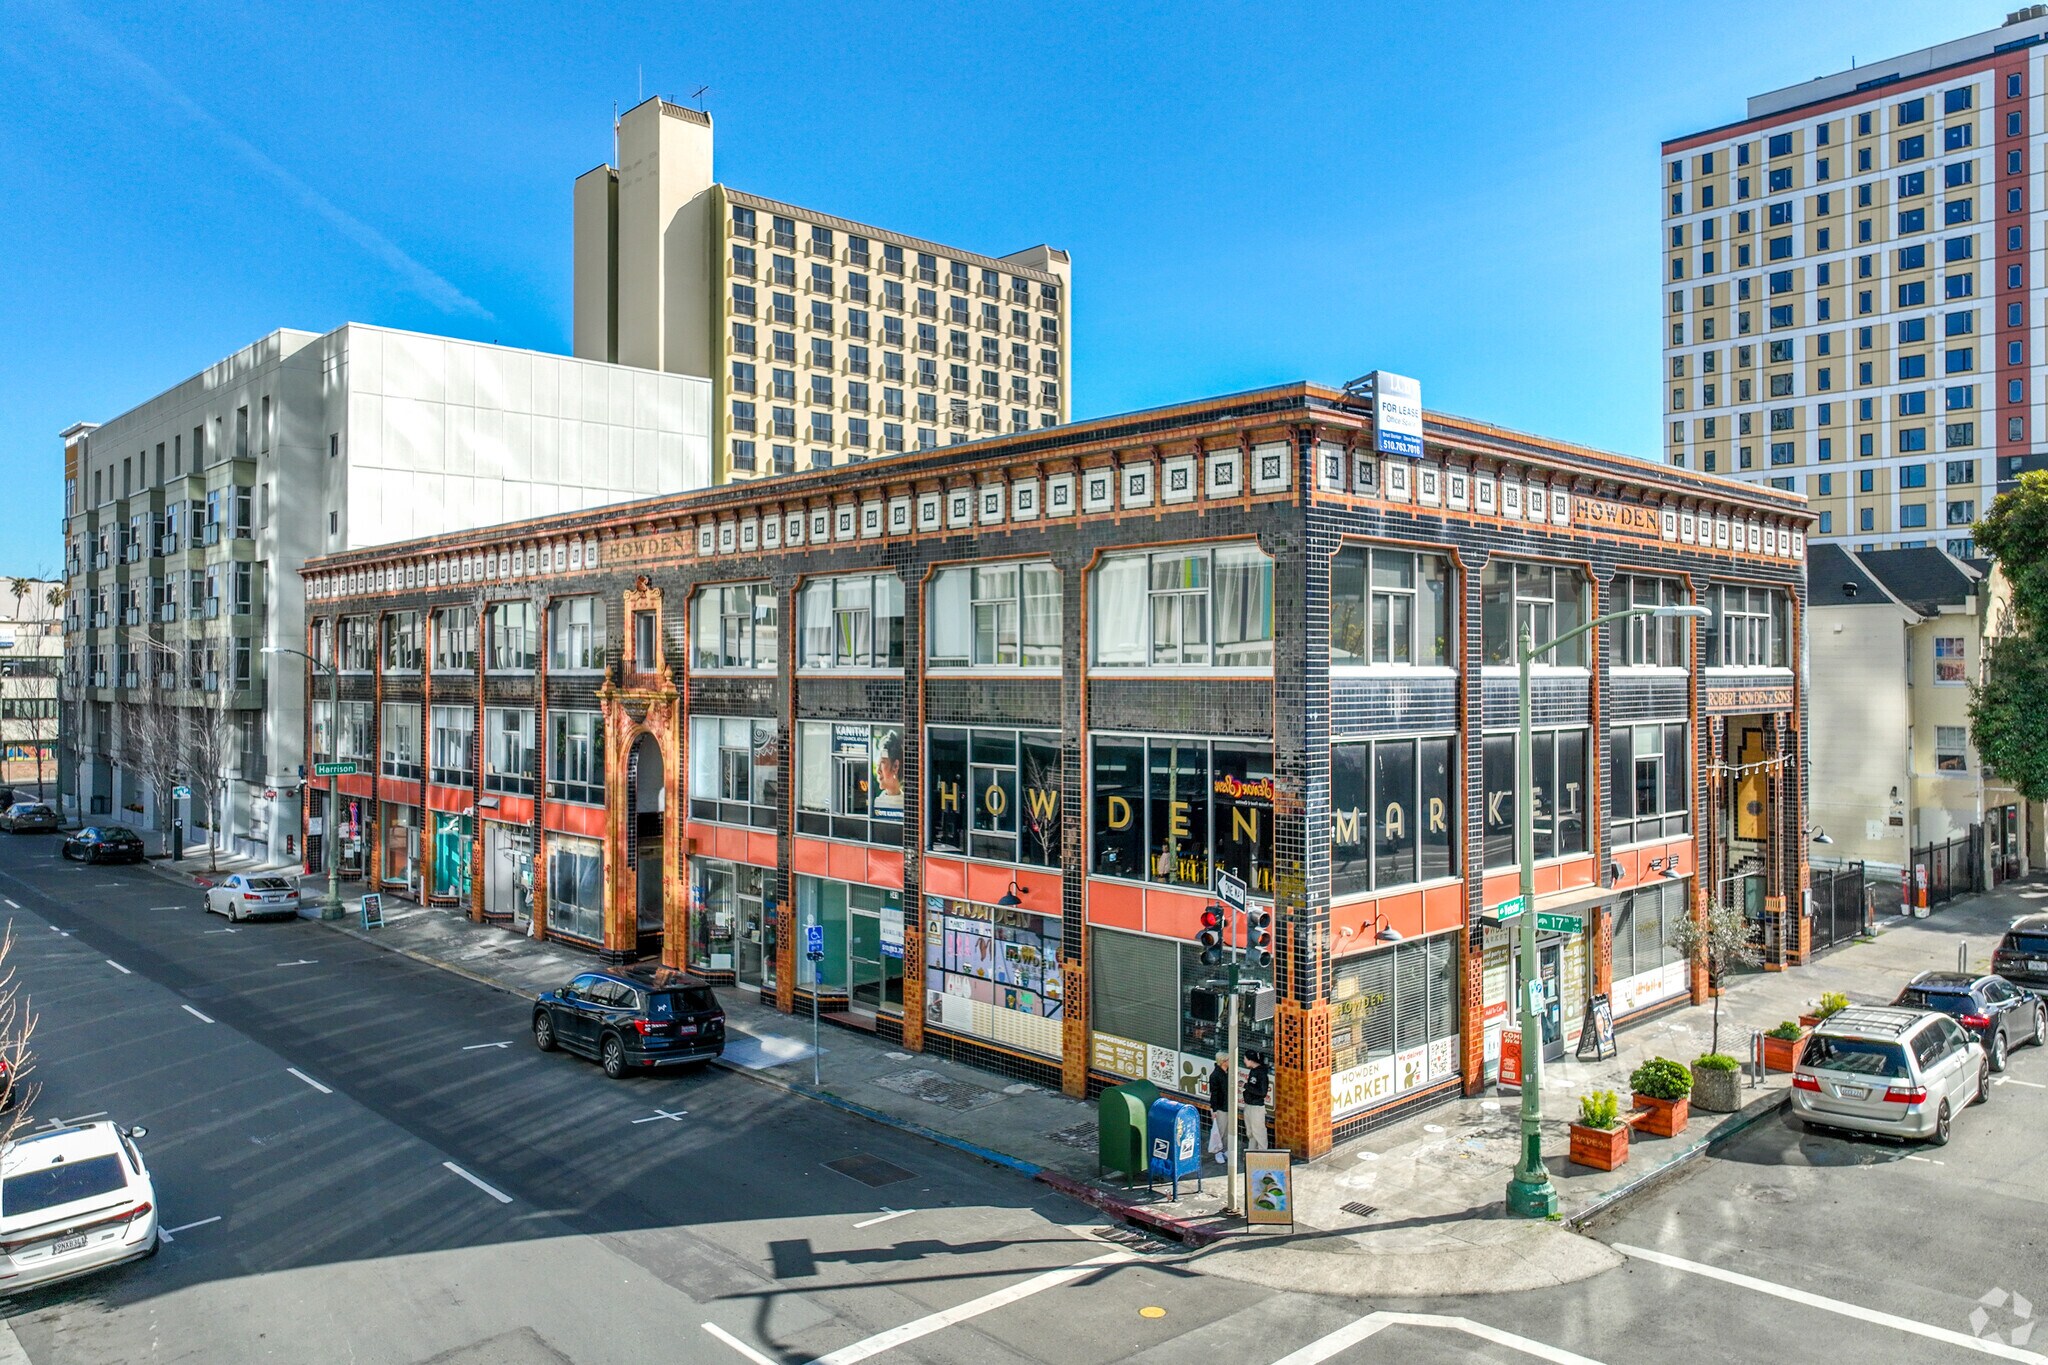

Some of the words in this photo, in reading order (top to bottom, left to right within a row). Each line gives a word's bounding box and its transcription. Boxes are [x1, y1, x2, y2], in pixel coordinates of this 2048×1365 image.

[1382, 401, 1397, 413] FOR
[1398, 405, 1419, 419] LEASE
[1386, 415, 1401, 425] Office
[1576, 498, 1657, 529] HOWDEN
[609, 535, 685, 559] HOWDEN
[1708, 692, 1736, 706] ROBERT
[1738, 691, 1768, 705] HOWDEN
[1774, 690, 1791, 703] SONS
[835, 725, 869, 737] KANITHA
[318, 765, 354, 774] Harrison
[940, 781, 1259, 844] HOWDEN
[1335, 782, 1581, 845] MARKET
[1226, 882, 1234, 896] ONE
[1234, 888, 1243, 900] WAY
[951, 901, 1031, 929] HOWDEN
[1551, 917, 1570, 929] 17th
[1485, 933, 1508, 944] ARKET
[1503, 1031, 1522, 1040] COM
[1342, 1063, 1379, 1085] HOWDEN
[1331, 1074, 1390, 1112] MARKET
